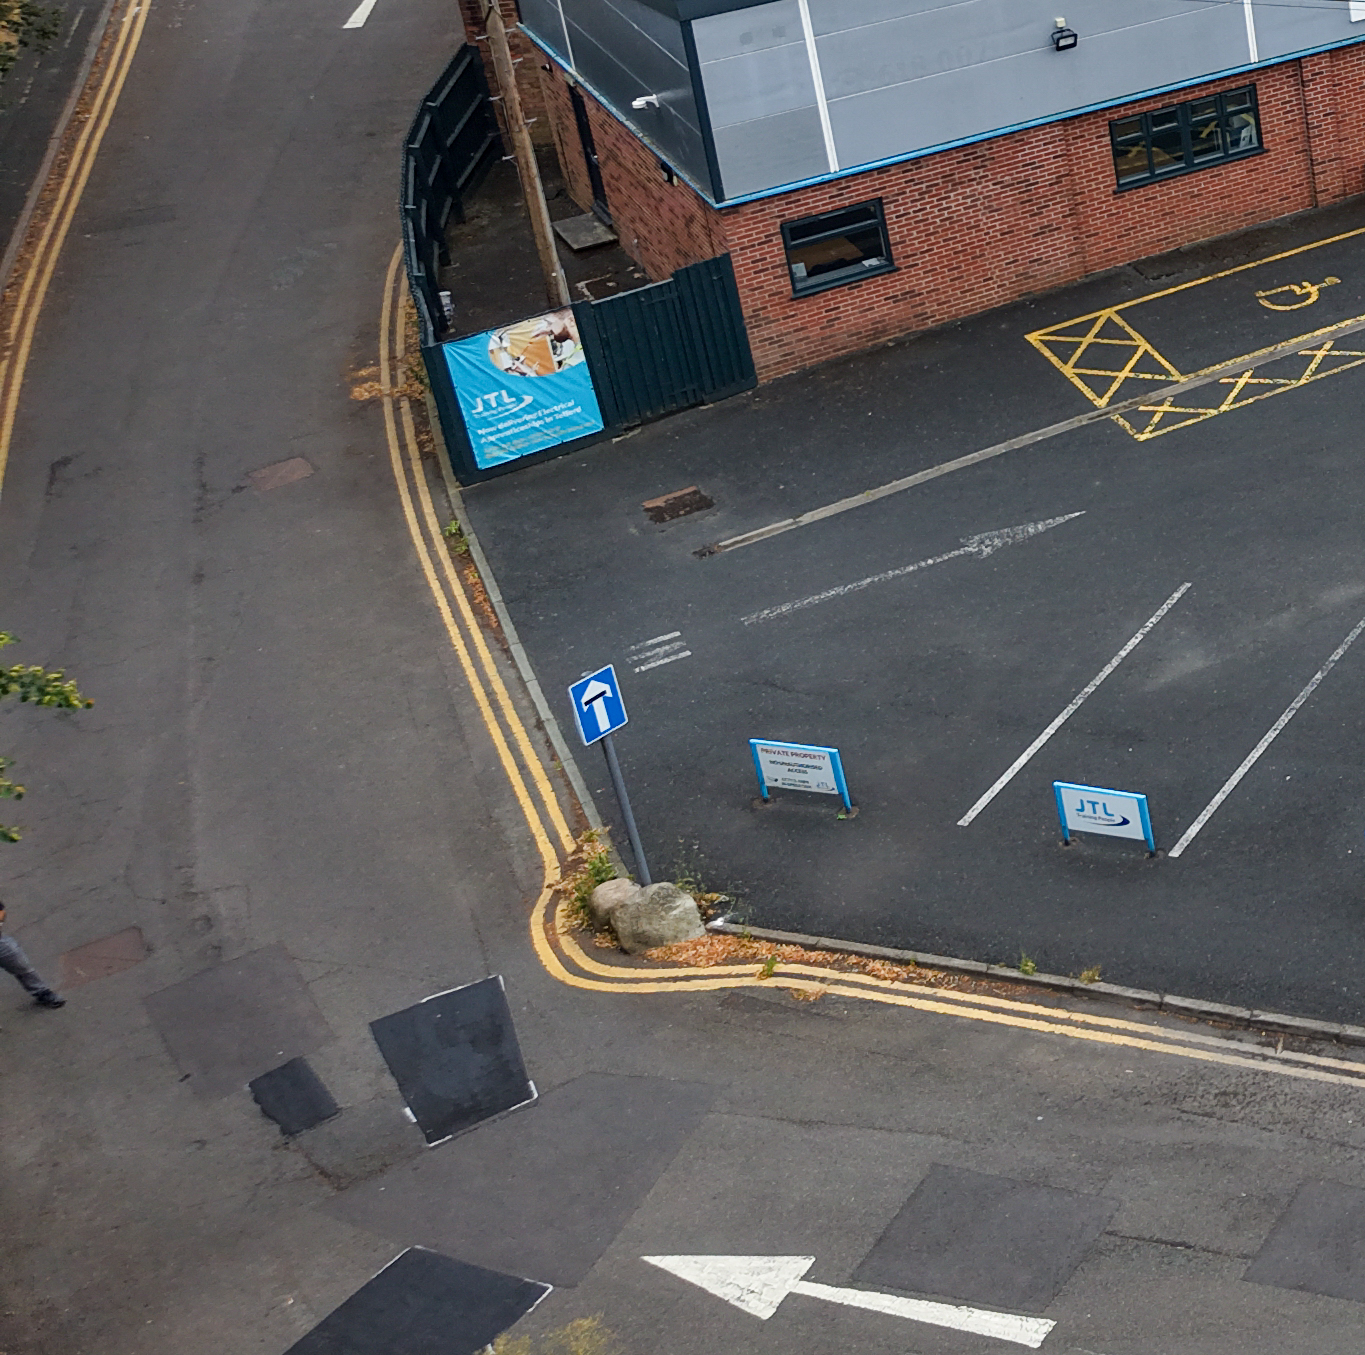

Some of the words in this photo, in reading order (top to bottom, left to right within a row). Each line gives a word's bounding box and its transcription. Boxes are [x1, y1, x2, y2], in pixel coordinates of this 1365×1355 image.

[472, 389, 516, 414] JTL
[477, 426, 497, 436] Now
[538, 399, 575, 417] Electrical
[480, 420, 545, 444] Apprenticeships
[554, 405, 582, 420] Telford
[760, 747, 789, 757] PRIVATE
[790, 751, 826, 761] PROPERTY
[1075, 798, 1115, 817] JTL
[1075, 812, 1098, 821] Training
